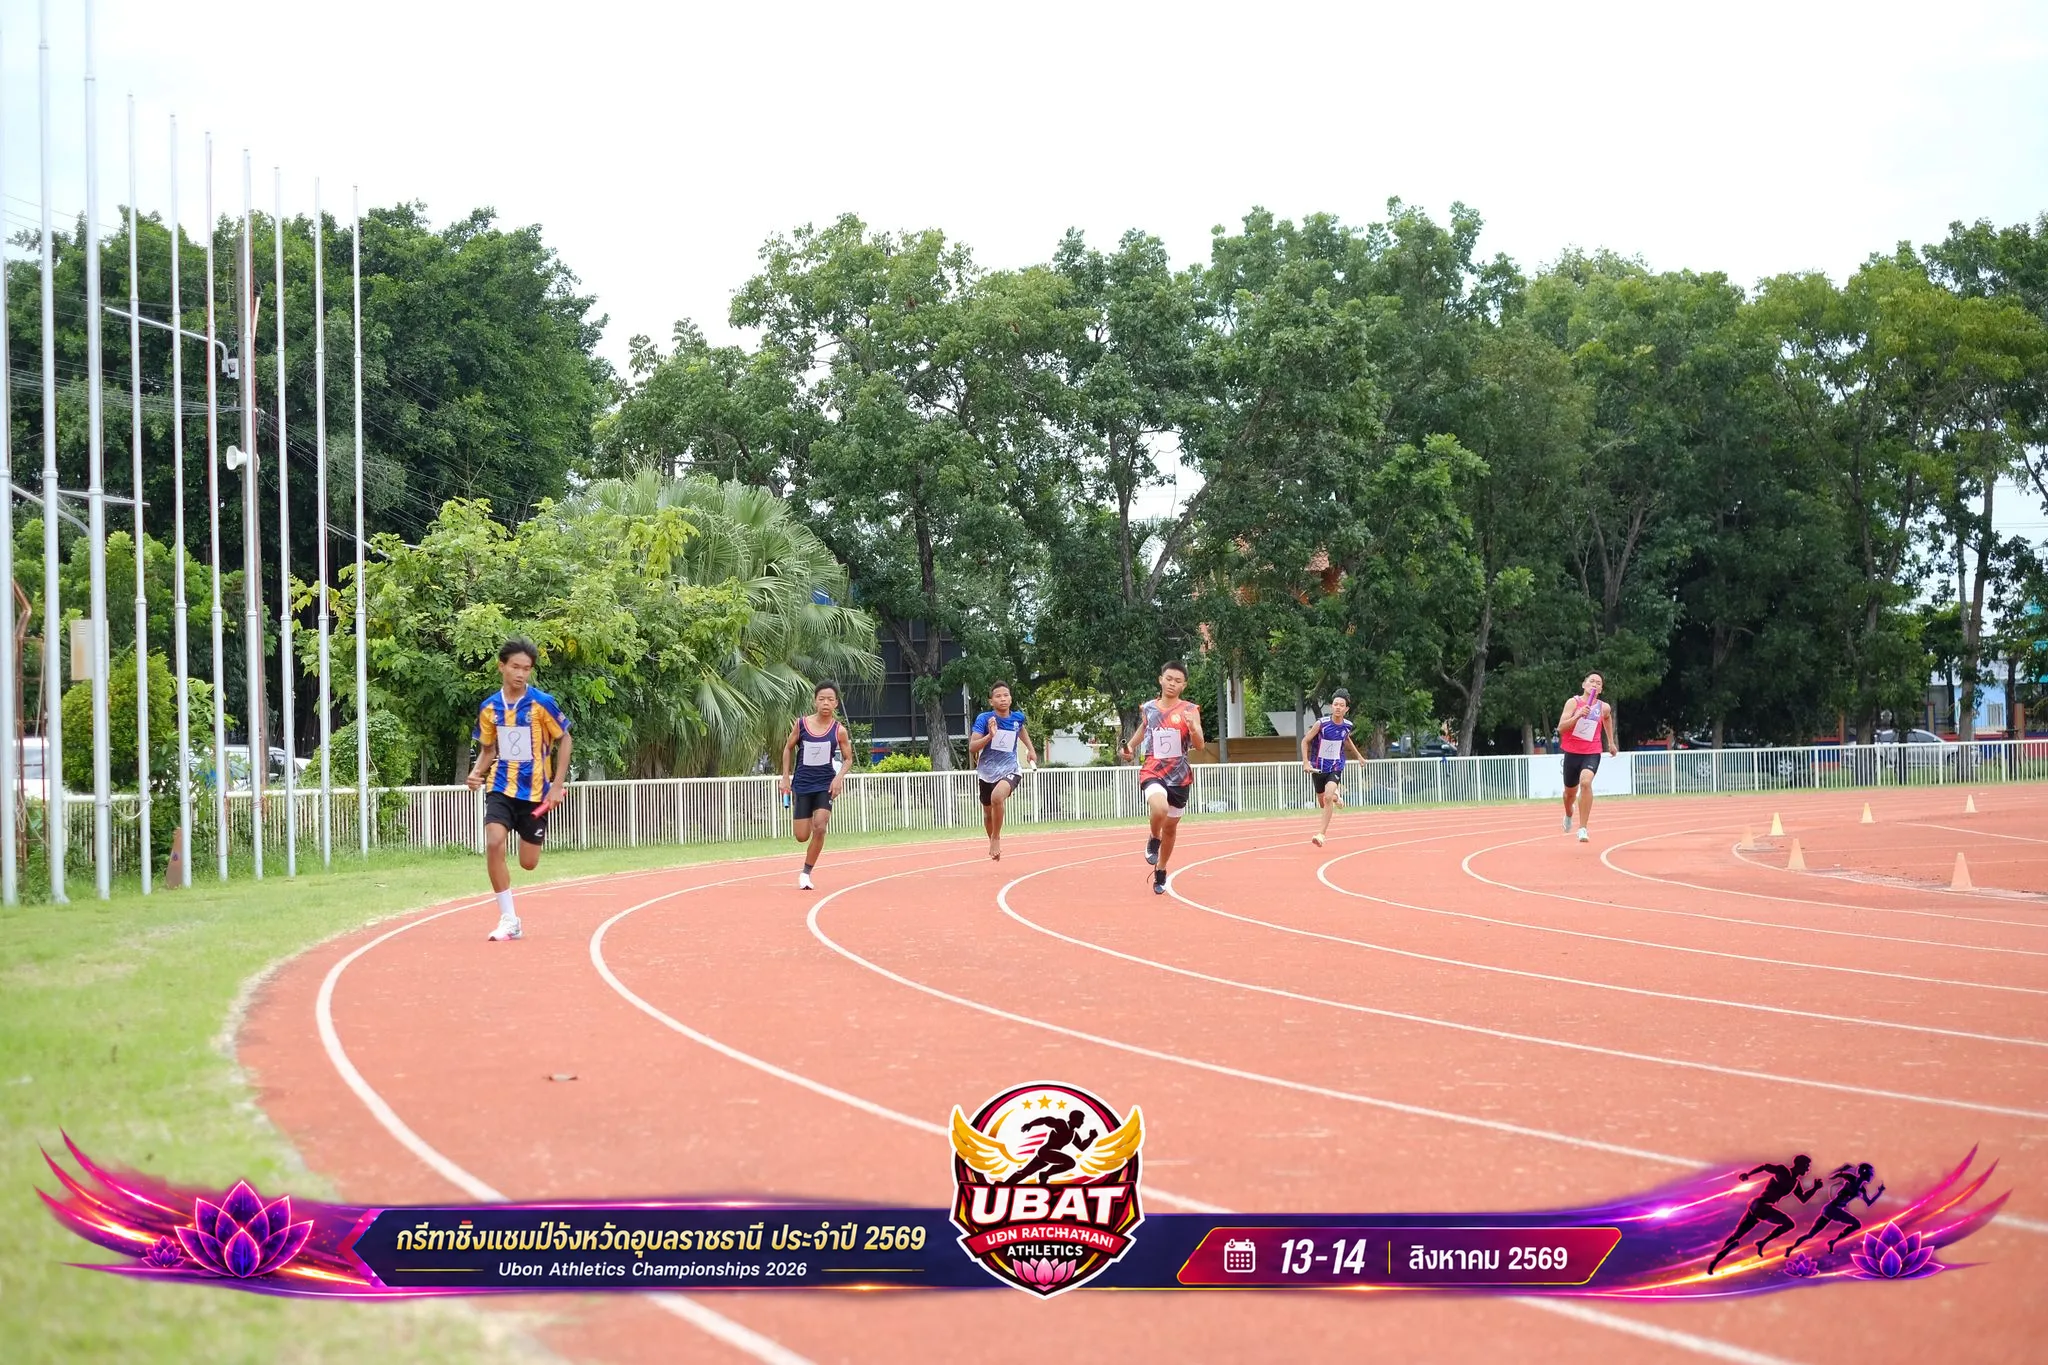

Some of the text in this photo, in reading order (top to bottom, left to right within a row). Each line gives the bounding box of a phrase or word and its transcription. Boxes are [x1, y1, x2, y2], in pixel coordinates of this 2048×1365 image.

[508, 731, 521, 756] 8
[808, 746, 822, 759] 7
[1160, 735, 1171, 755] 5
